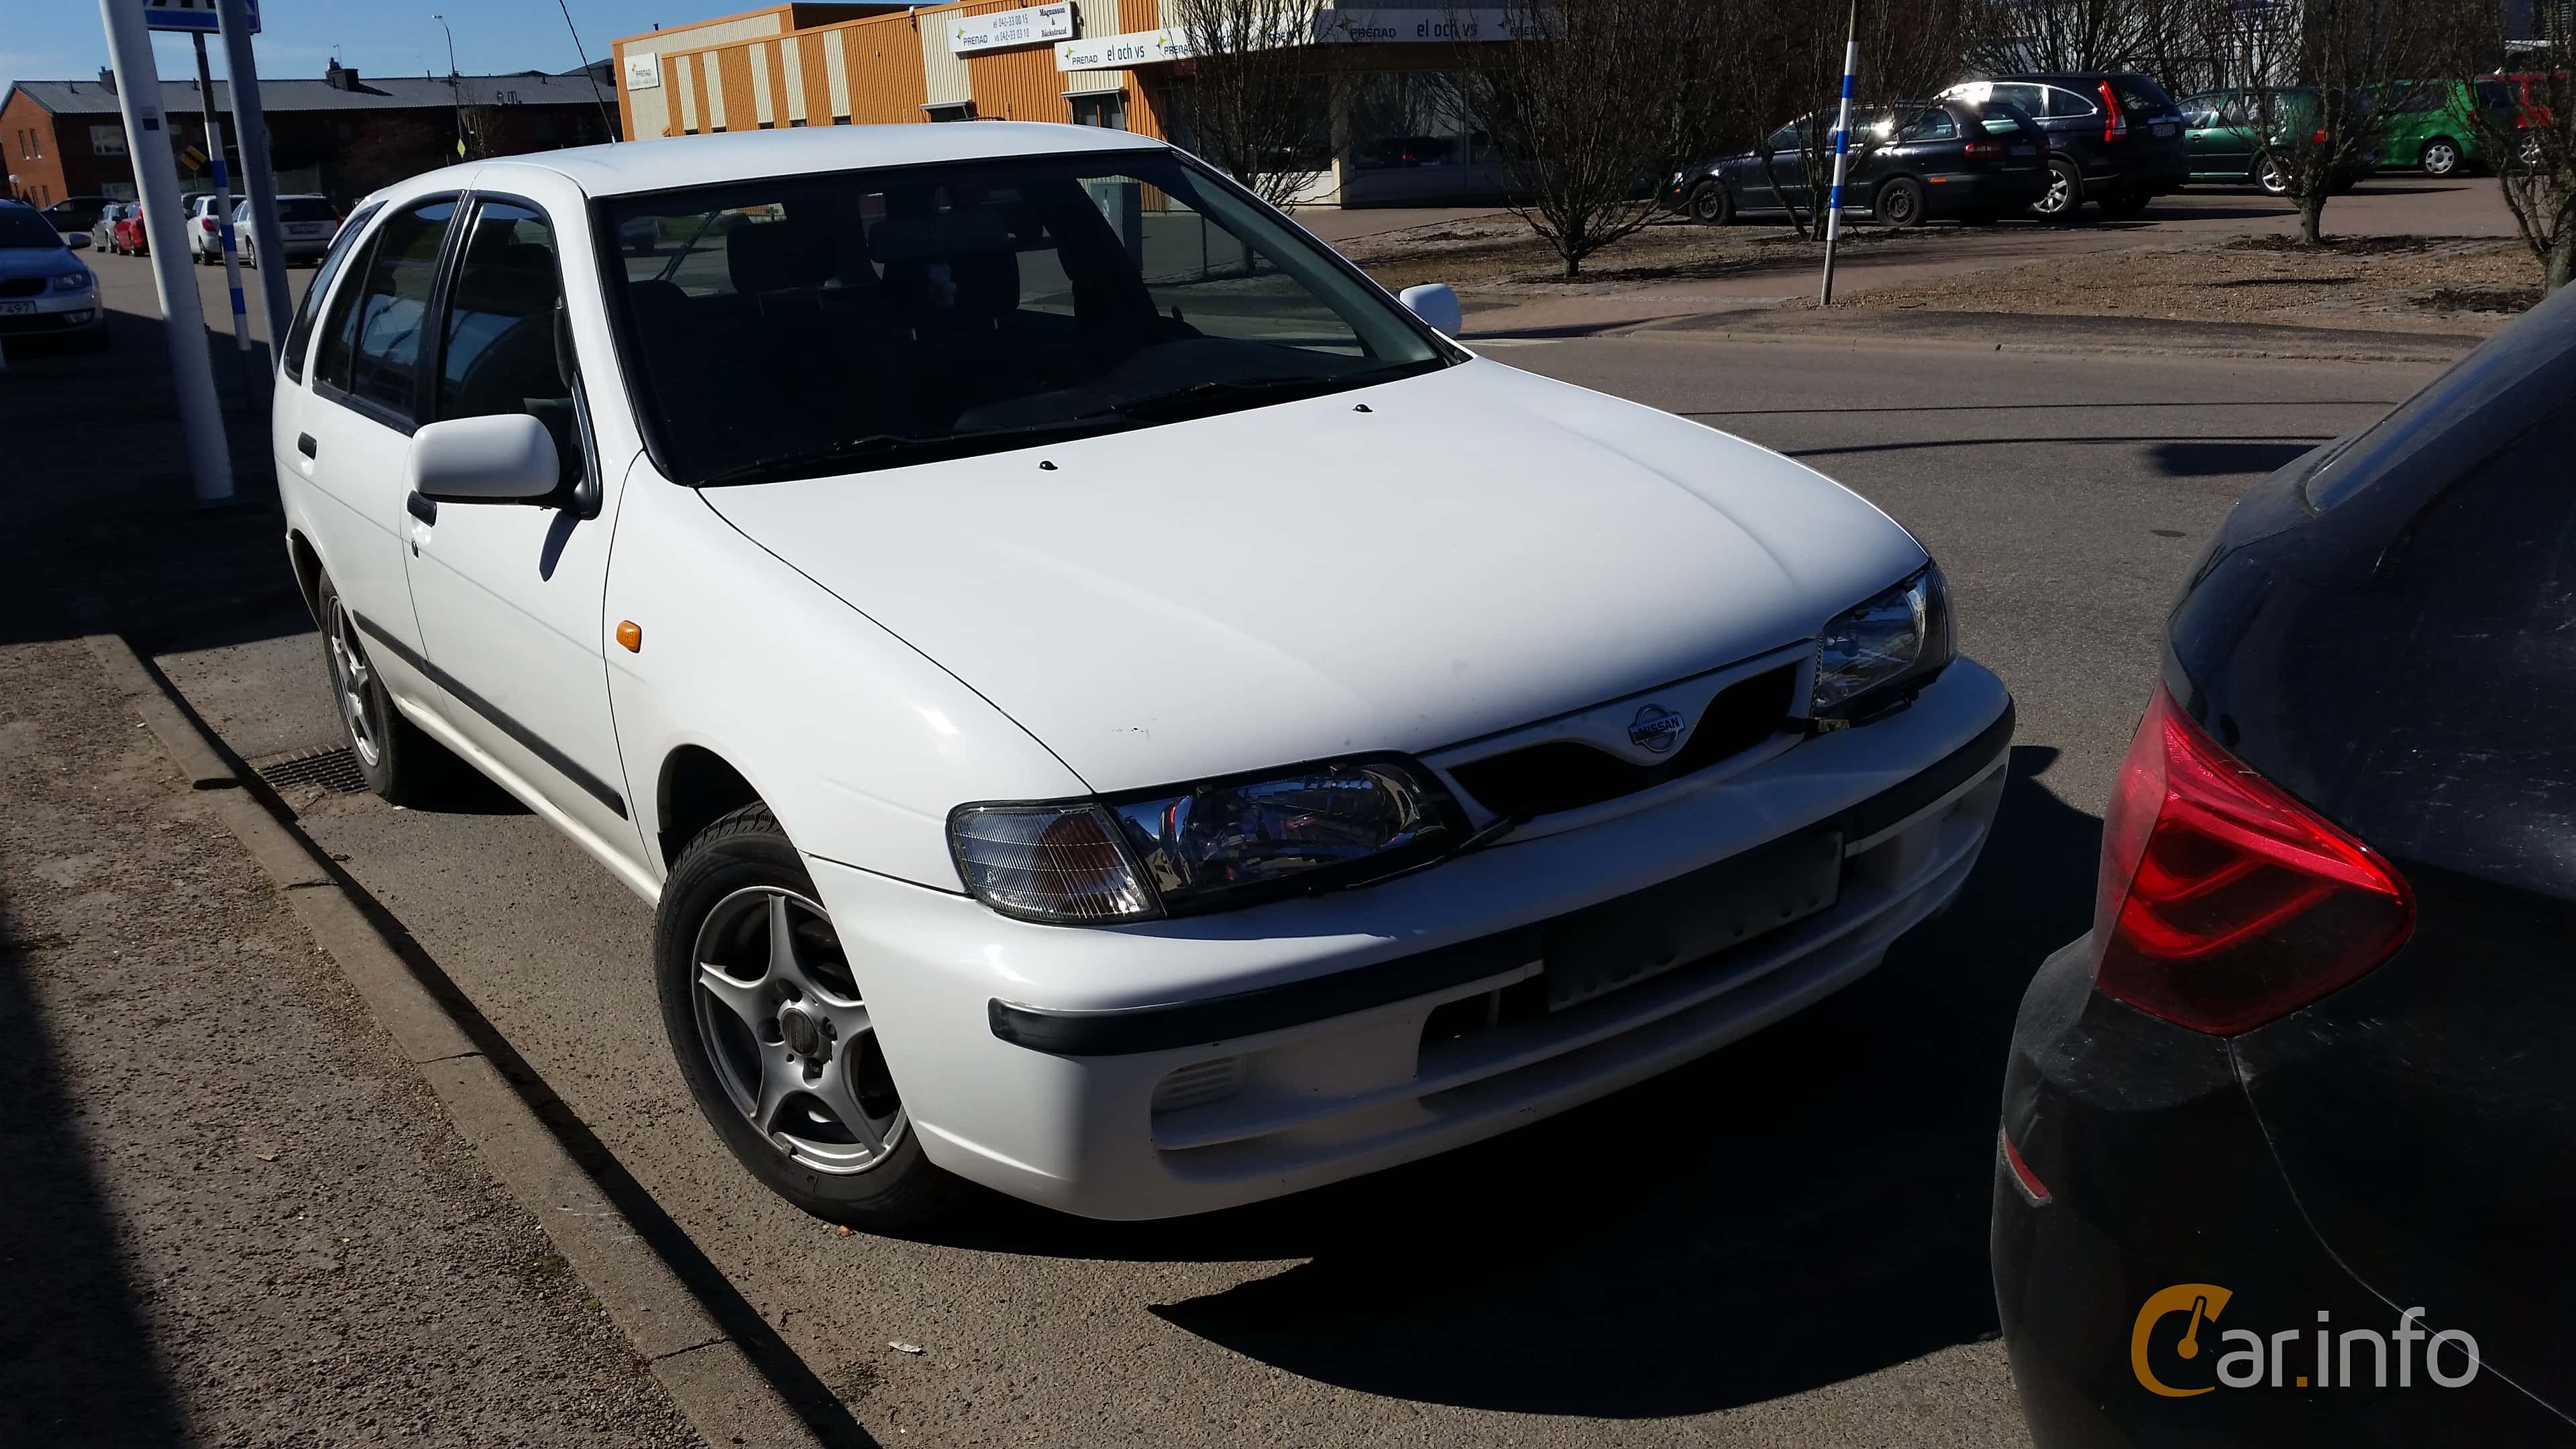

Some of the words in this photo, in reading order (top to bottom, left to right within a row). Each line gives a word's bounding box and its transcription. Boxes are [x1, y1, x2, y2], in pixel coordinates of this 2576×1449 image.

[1039, 7, 1065, 17] Magnusson
[994, 18, 998, 28] el
[999, 16, 1014, 28] 042-33
[1023, 13, 1028, 24] 15
[1051, 17, 1056, 25] &
[1041, 27, 1067, 38] Bäckstrand
[1417, 19, 1430, 38] el
[963, 34, 988, 46] PRENAD
[1072, 54, 1098, 65] PRENAD
[1108, 44, 1115, 62] el
[1118, 42, 1133, 60] och
[1135, 45, 1144, 59] vs
